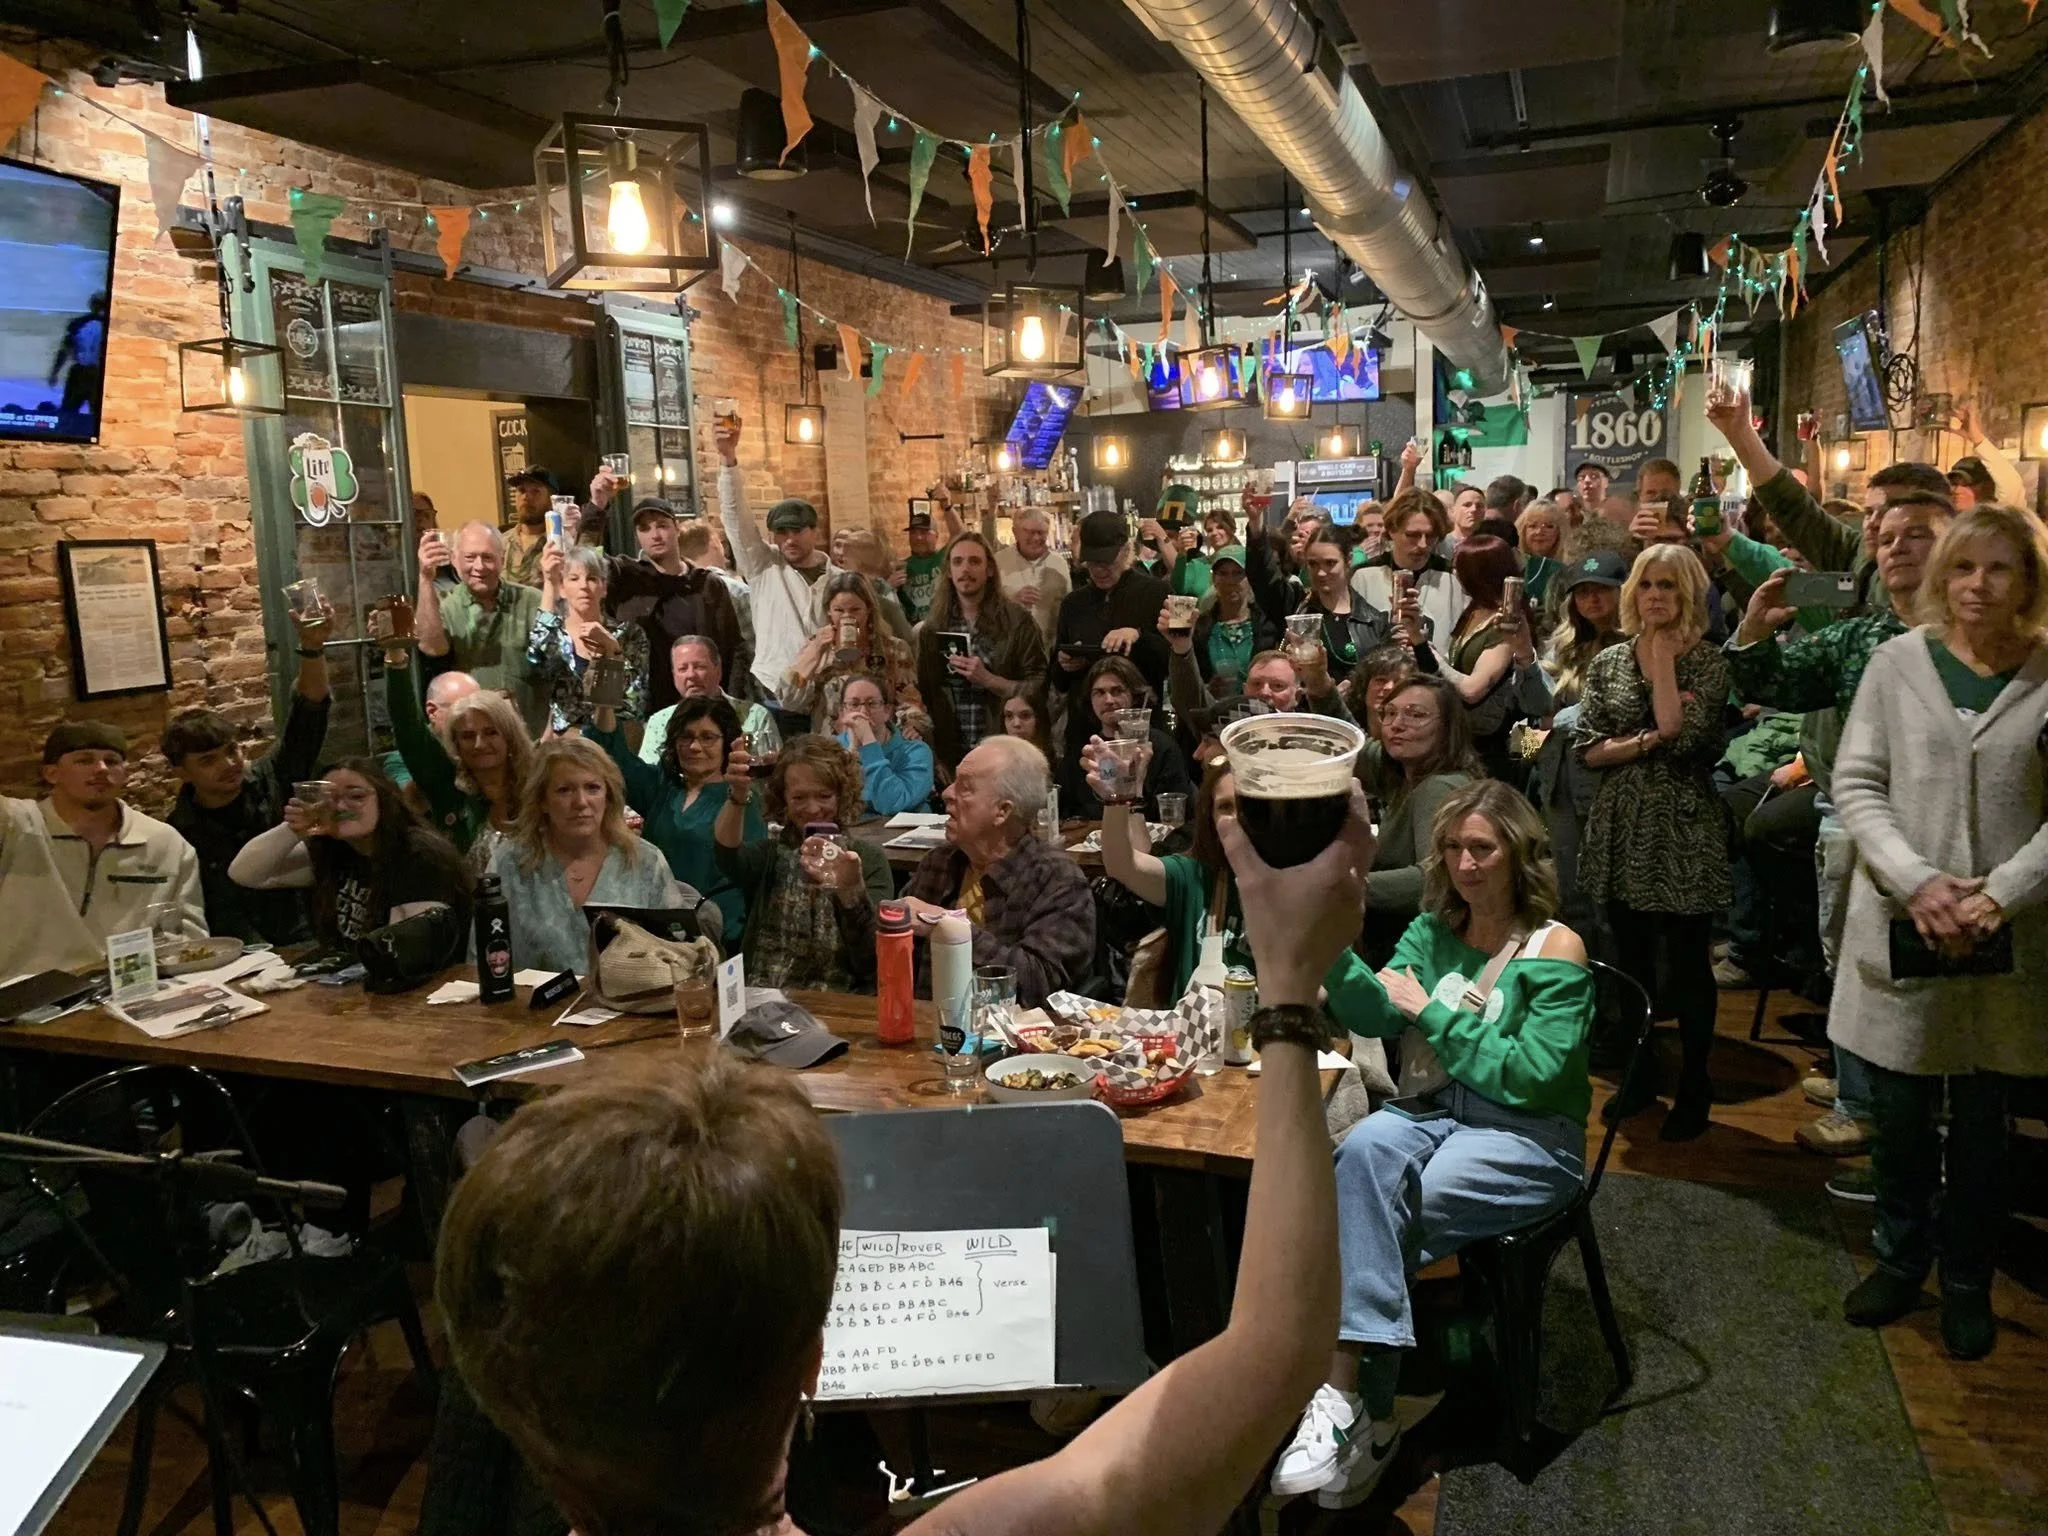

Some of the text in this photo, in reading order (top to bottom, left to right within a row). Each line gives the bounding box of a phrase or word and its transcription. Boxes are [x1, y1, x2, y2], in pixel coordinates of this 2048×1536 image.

[1571, 410, 1662, 449] 1860
[1588, 452, 1643, 463] BOTTLESHOP
[307, 458, 329, 480] Lite
[861, 1243, 894, 1253] WILD
[902, 1243, 943, 1253] ROVER
[966, 1234, 1012, 1250] WILD
[993, 1280, 1028, 1288] verse
